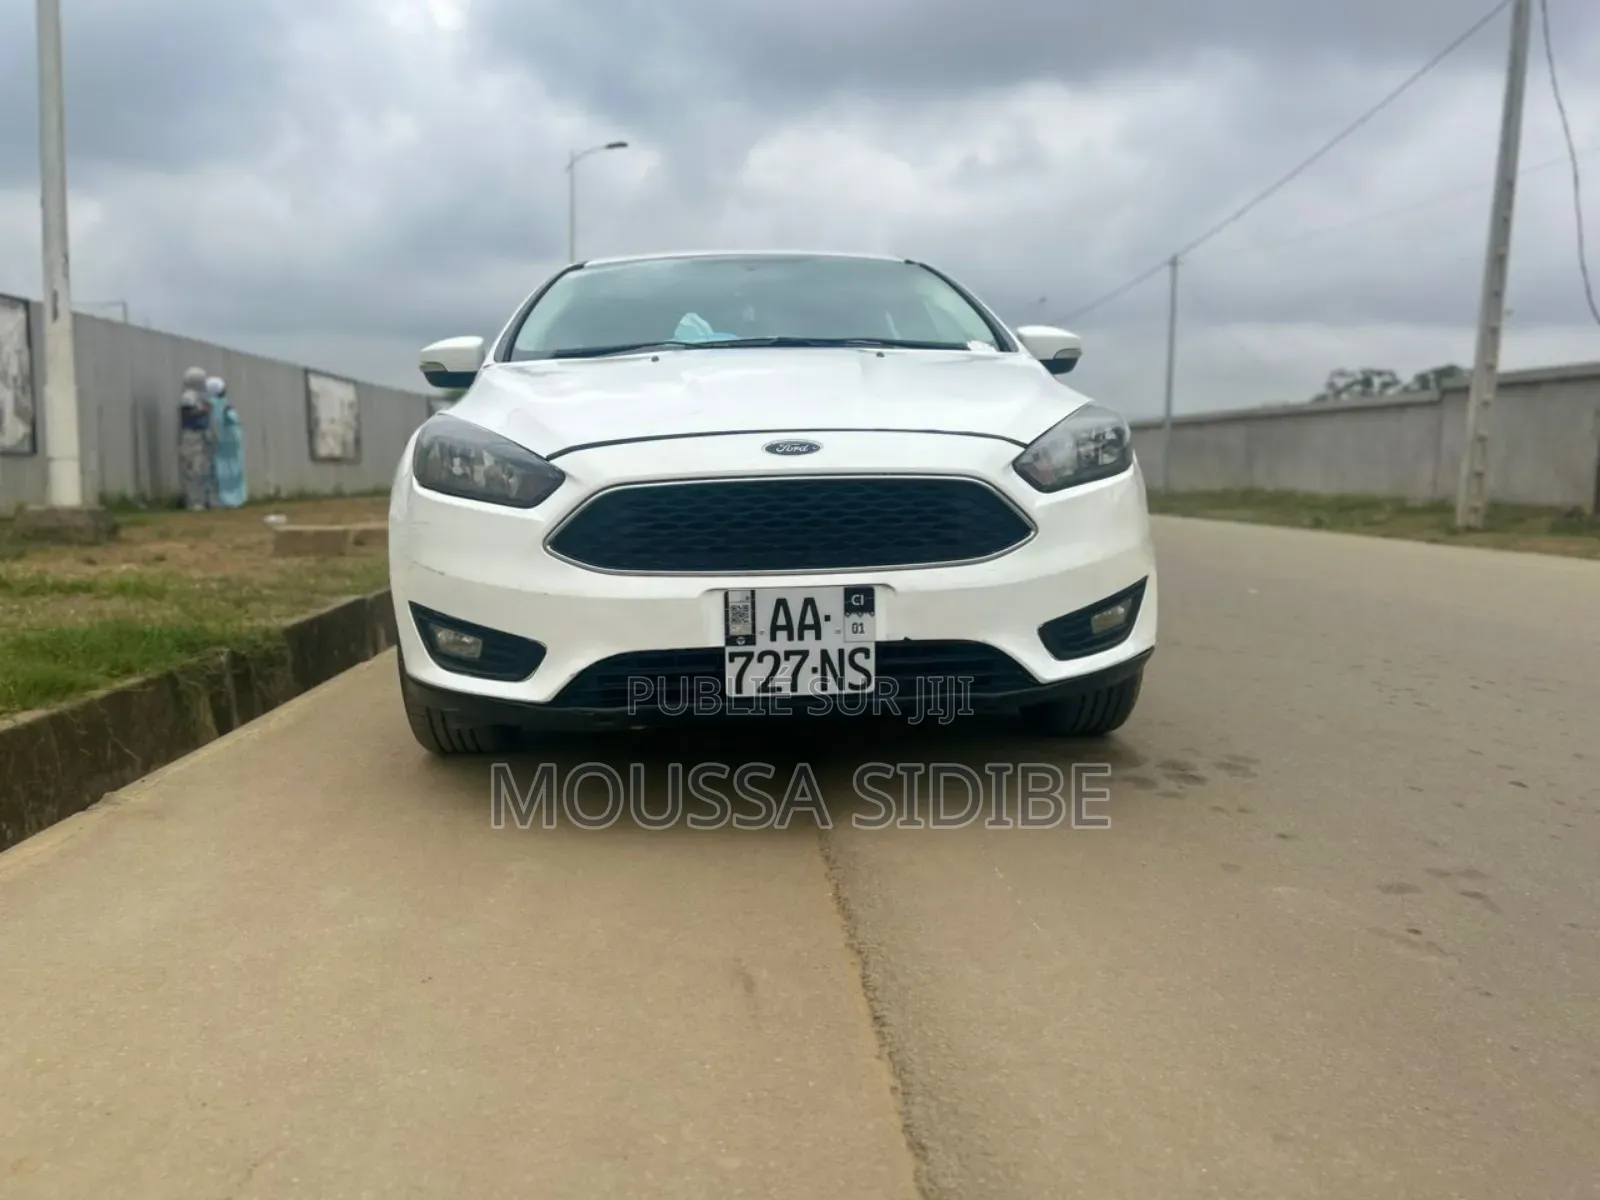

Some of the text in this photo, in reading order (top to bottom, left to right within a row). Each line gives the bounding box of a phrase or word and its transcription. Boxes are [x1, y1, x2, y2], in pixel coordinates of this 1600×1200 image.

[775, 443, 809, 454] Ford
[850, 594, 865, 606] CI
[851, 622, 866, 634] 01
